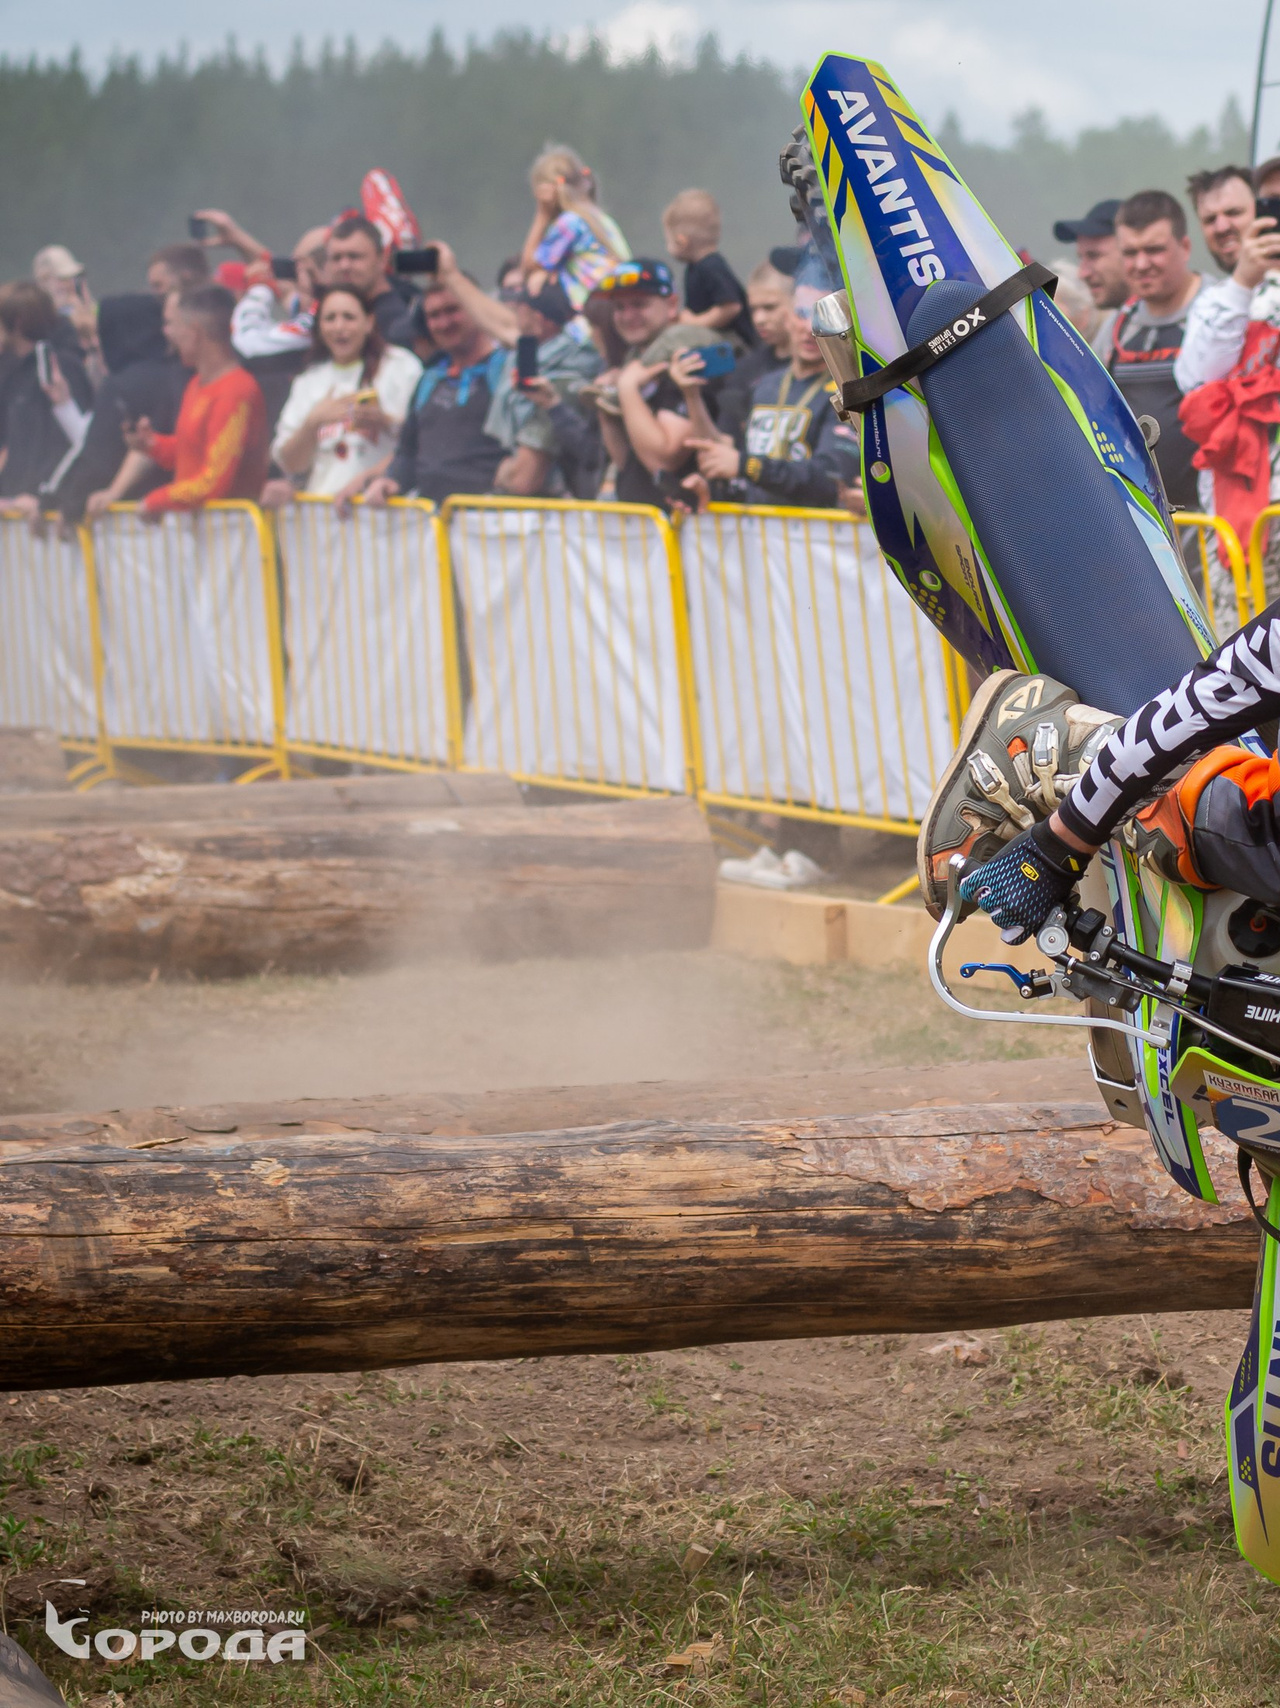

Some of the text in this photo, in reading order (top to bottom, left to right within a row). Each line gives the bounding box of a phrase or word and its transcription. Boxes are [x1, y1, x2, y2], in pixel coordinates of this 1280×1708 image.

[827, 90, 946, 287] AVANTIS
[1157, 1047, 1175, 1126] EXCEL
[1208, 1074, 1280, 1103] КУЗЯМБАЙ
